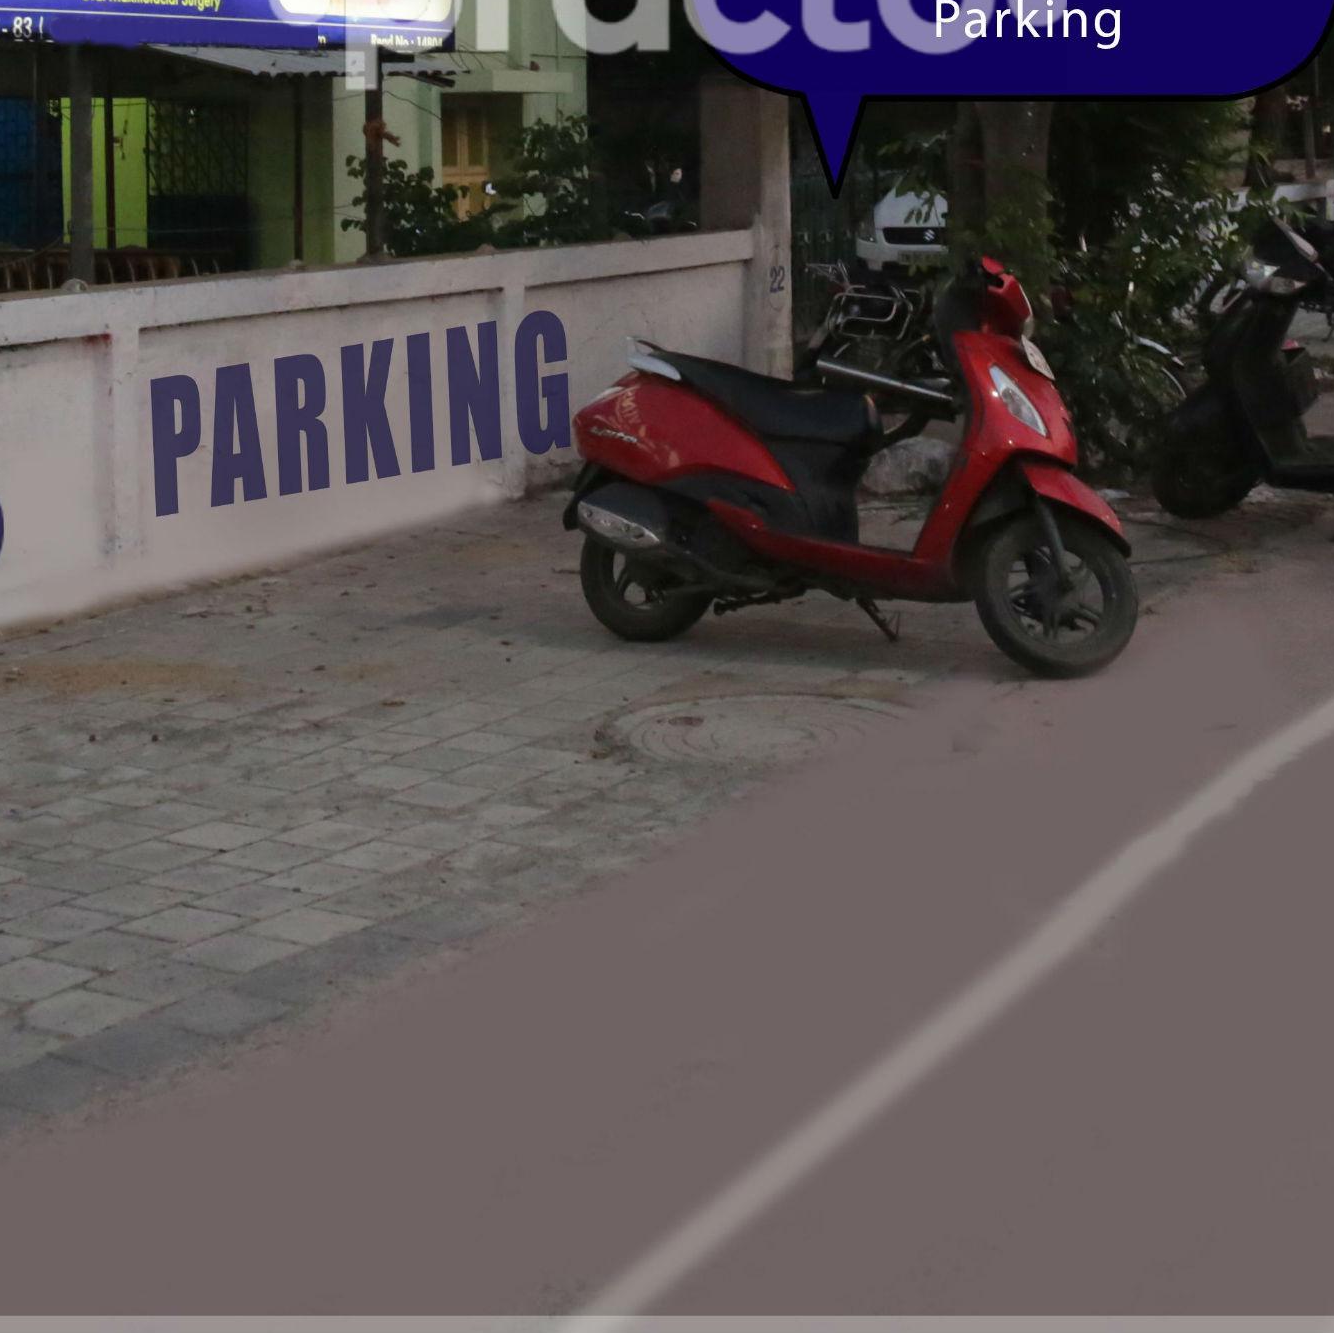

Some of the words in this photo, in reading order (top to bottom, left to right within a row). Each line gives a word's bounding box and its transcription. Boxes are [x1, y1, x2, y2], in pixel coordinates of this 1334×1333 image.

[13, 16, 32, 38] 83
[770, 266, 785, 293] 22
[152, 309, 573, 516] PARKING
